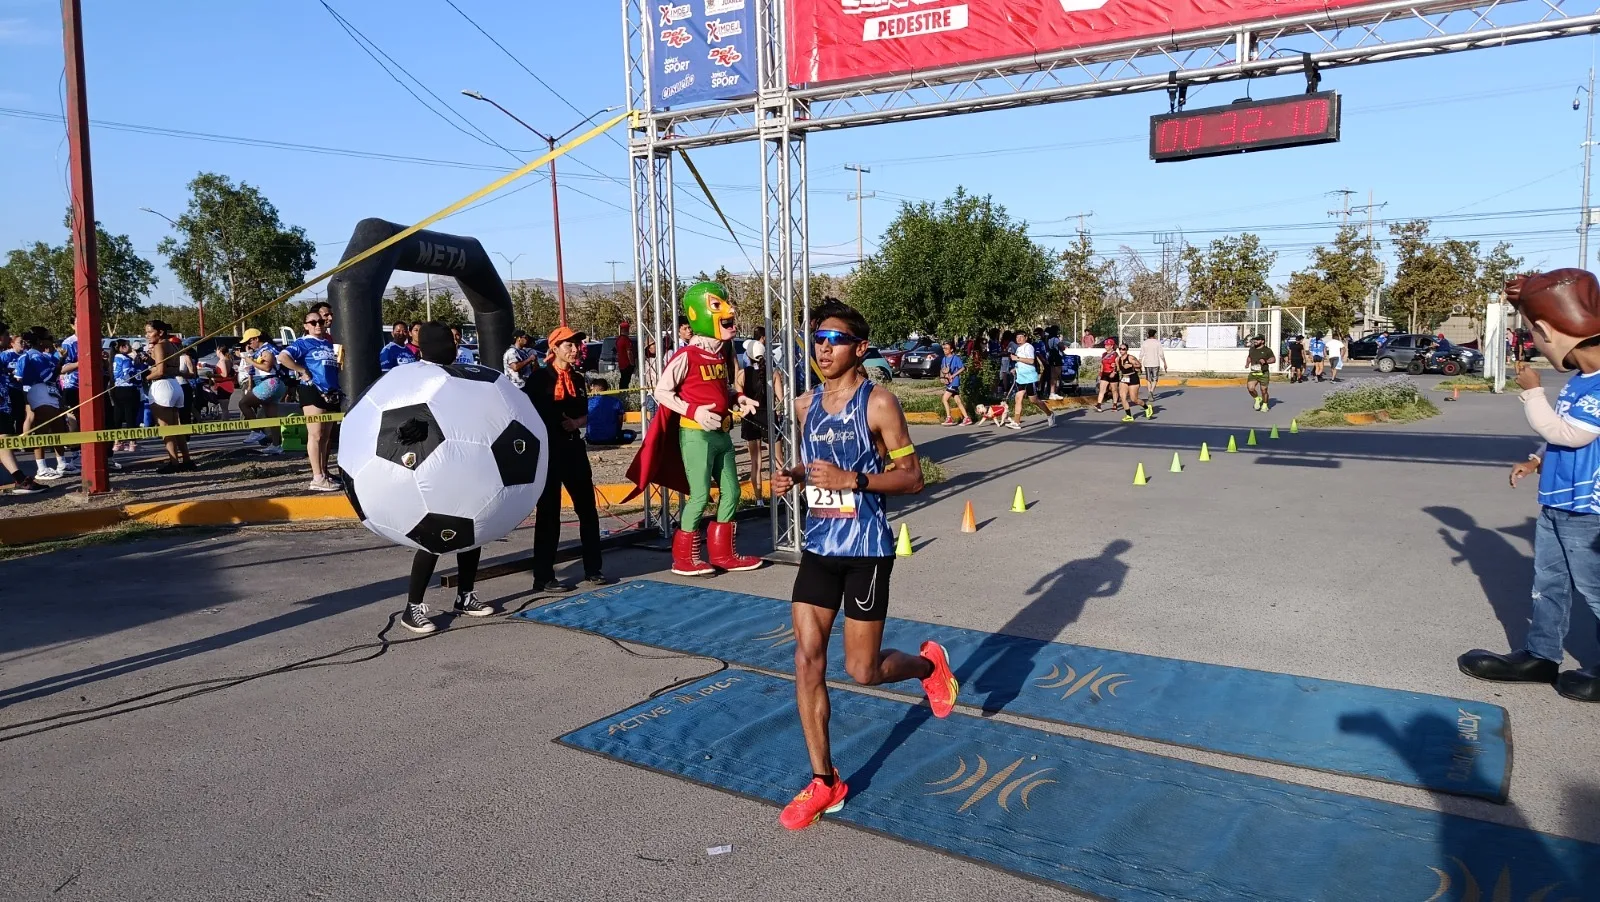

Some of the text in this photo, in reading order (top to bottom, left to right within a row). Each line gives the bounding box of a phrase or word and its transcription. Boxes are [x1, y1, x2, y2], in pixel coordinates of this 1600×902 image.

[878, 10, 951, 37] PEDESTRE
[664, 60, 690, 74] SPORT
[711, 74, 740, 89] SPORT
[416, 240, 467, 270] META
[813, 488, 844, 505] 231
[608, 706, 671, 736] ACTIVE
